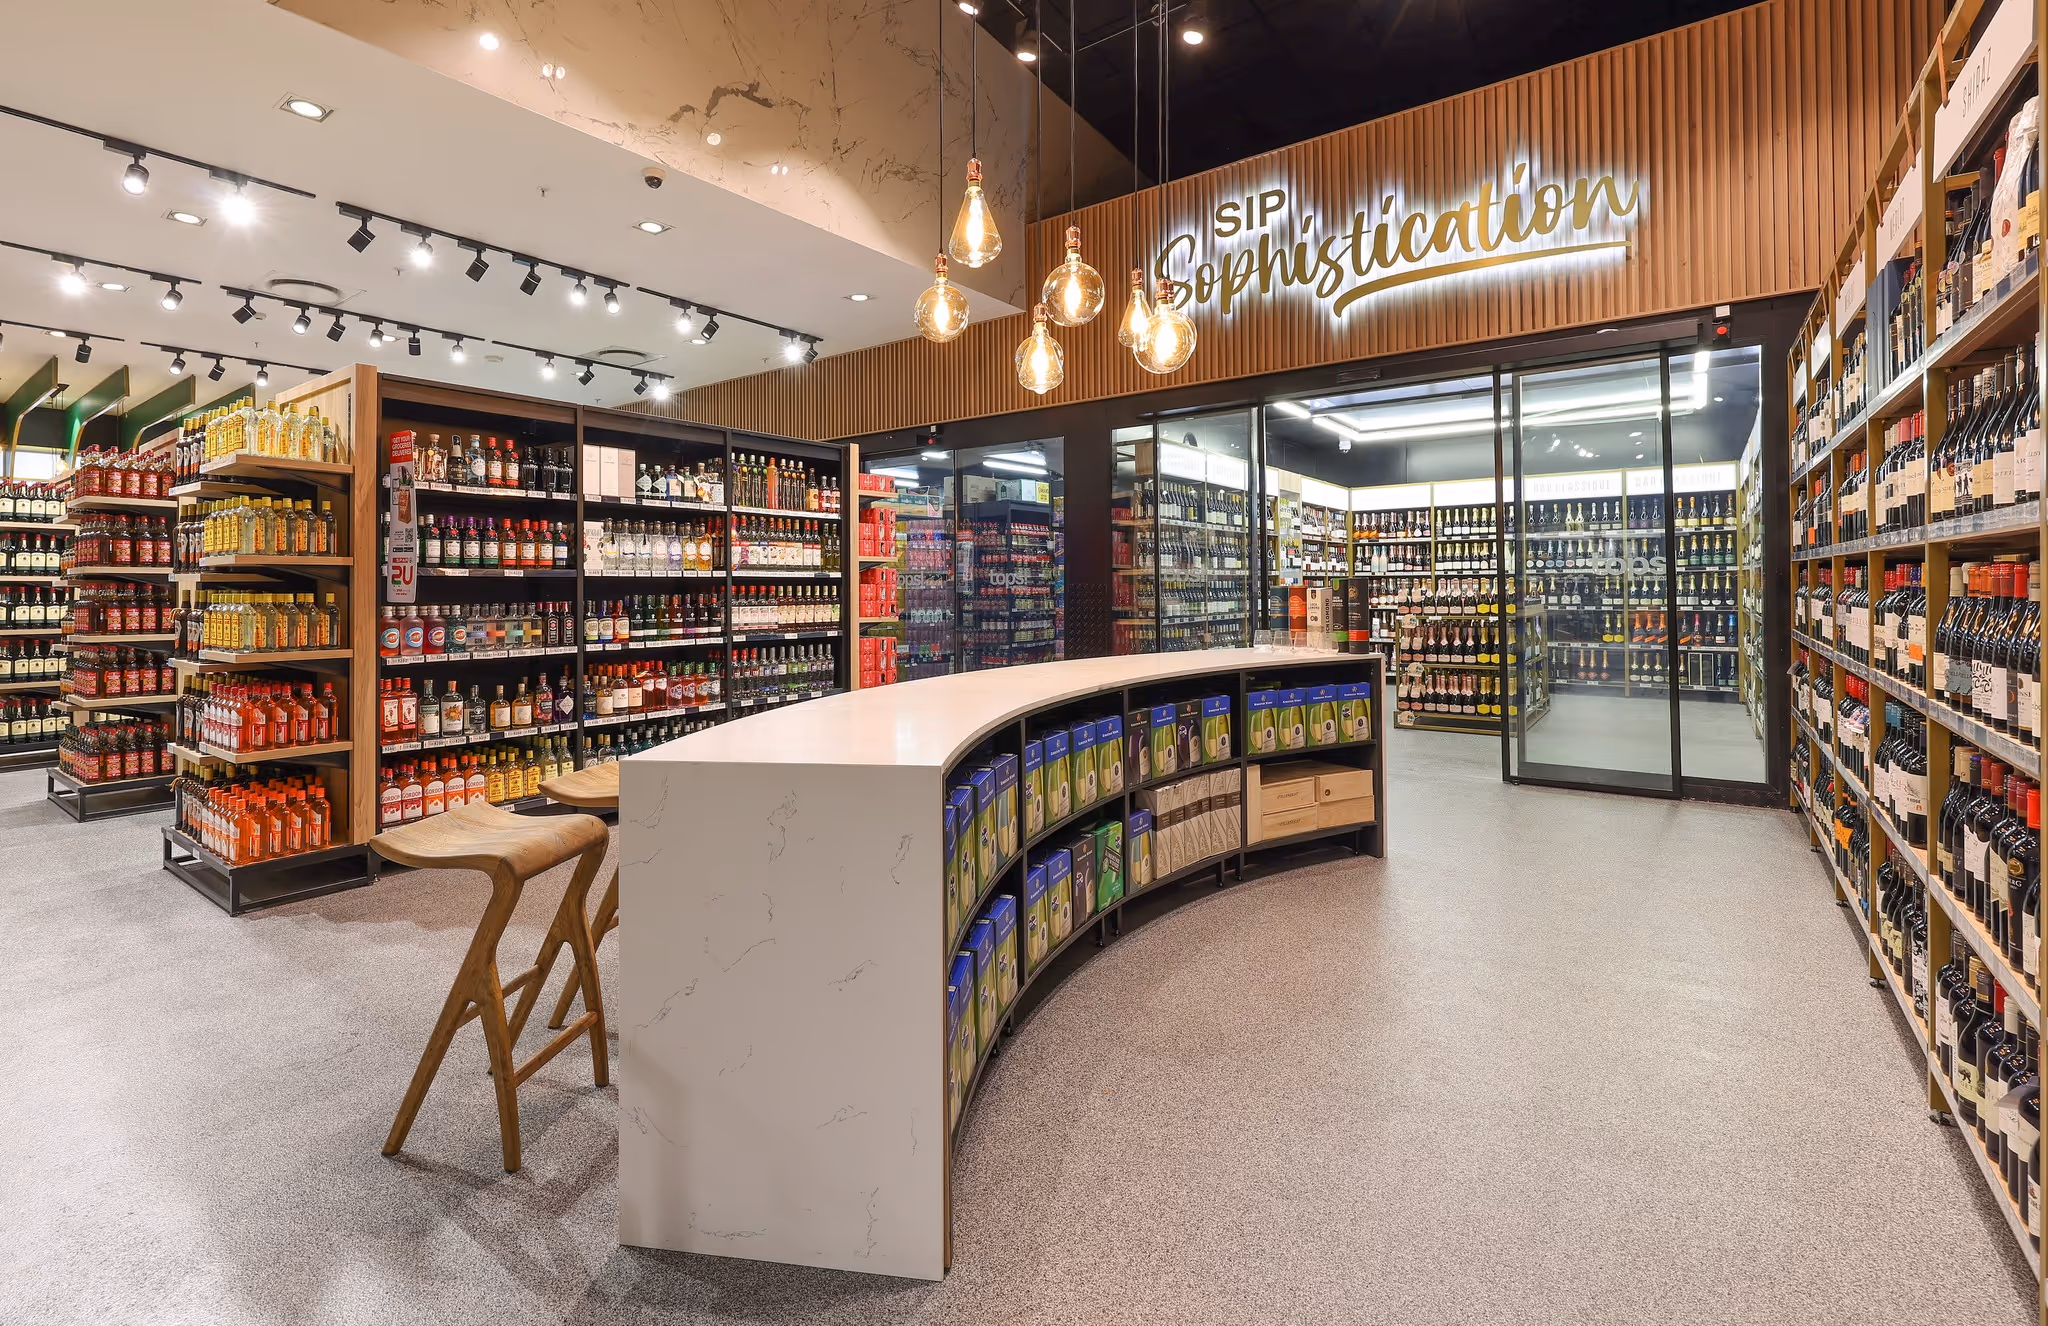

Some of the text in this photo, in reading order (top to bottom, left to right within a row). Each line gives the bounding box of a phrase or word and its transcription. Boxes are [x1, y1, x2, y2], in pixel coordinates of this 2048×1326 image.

[1962, 46, 1992, 118] SHIRAZ
[1215, 188, 1286, 238] SIP
[1155, 162, 1640, 316] Sophistication
[392, 442, 412, 450] GROCERIES
[392, 448, 412, 457] DELIVERED
[392, 565, 413, 585] 2U
[897, 572, 925, 588] ops!
[989, 569, 1029, 588] tops!
